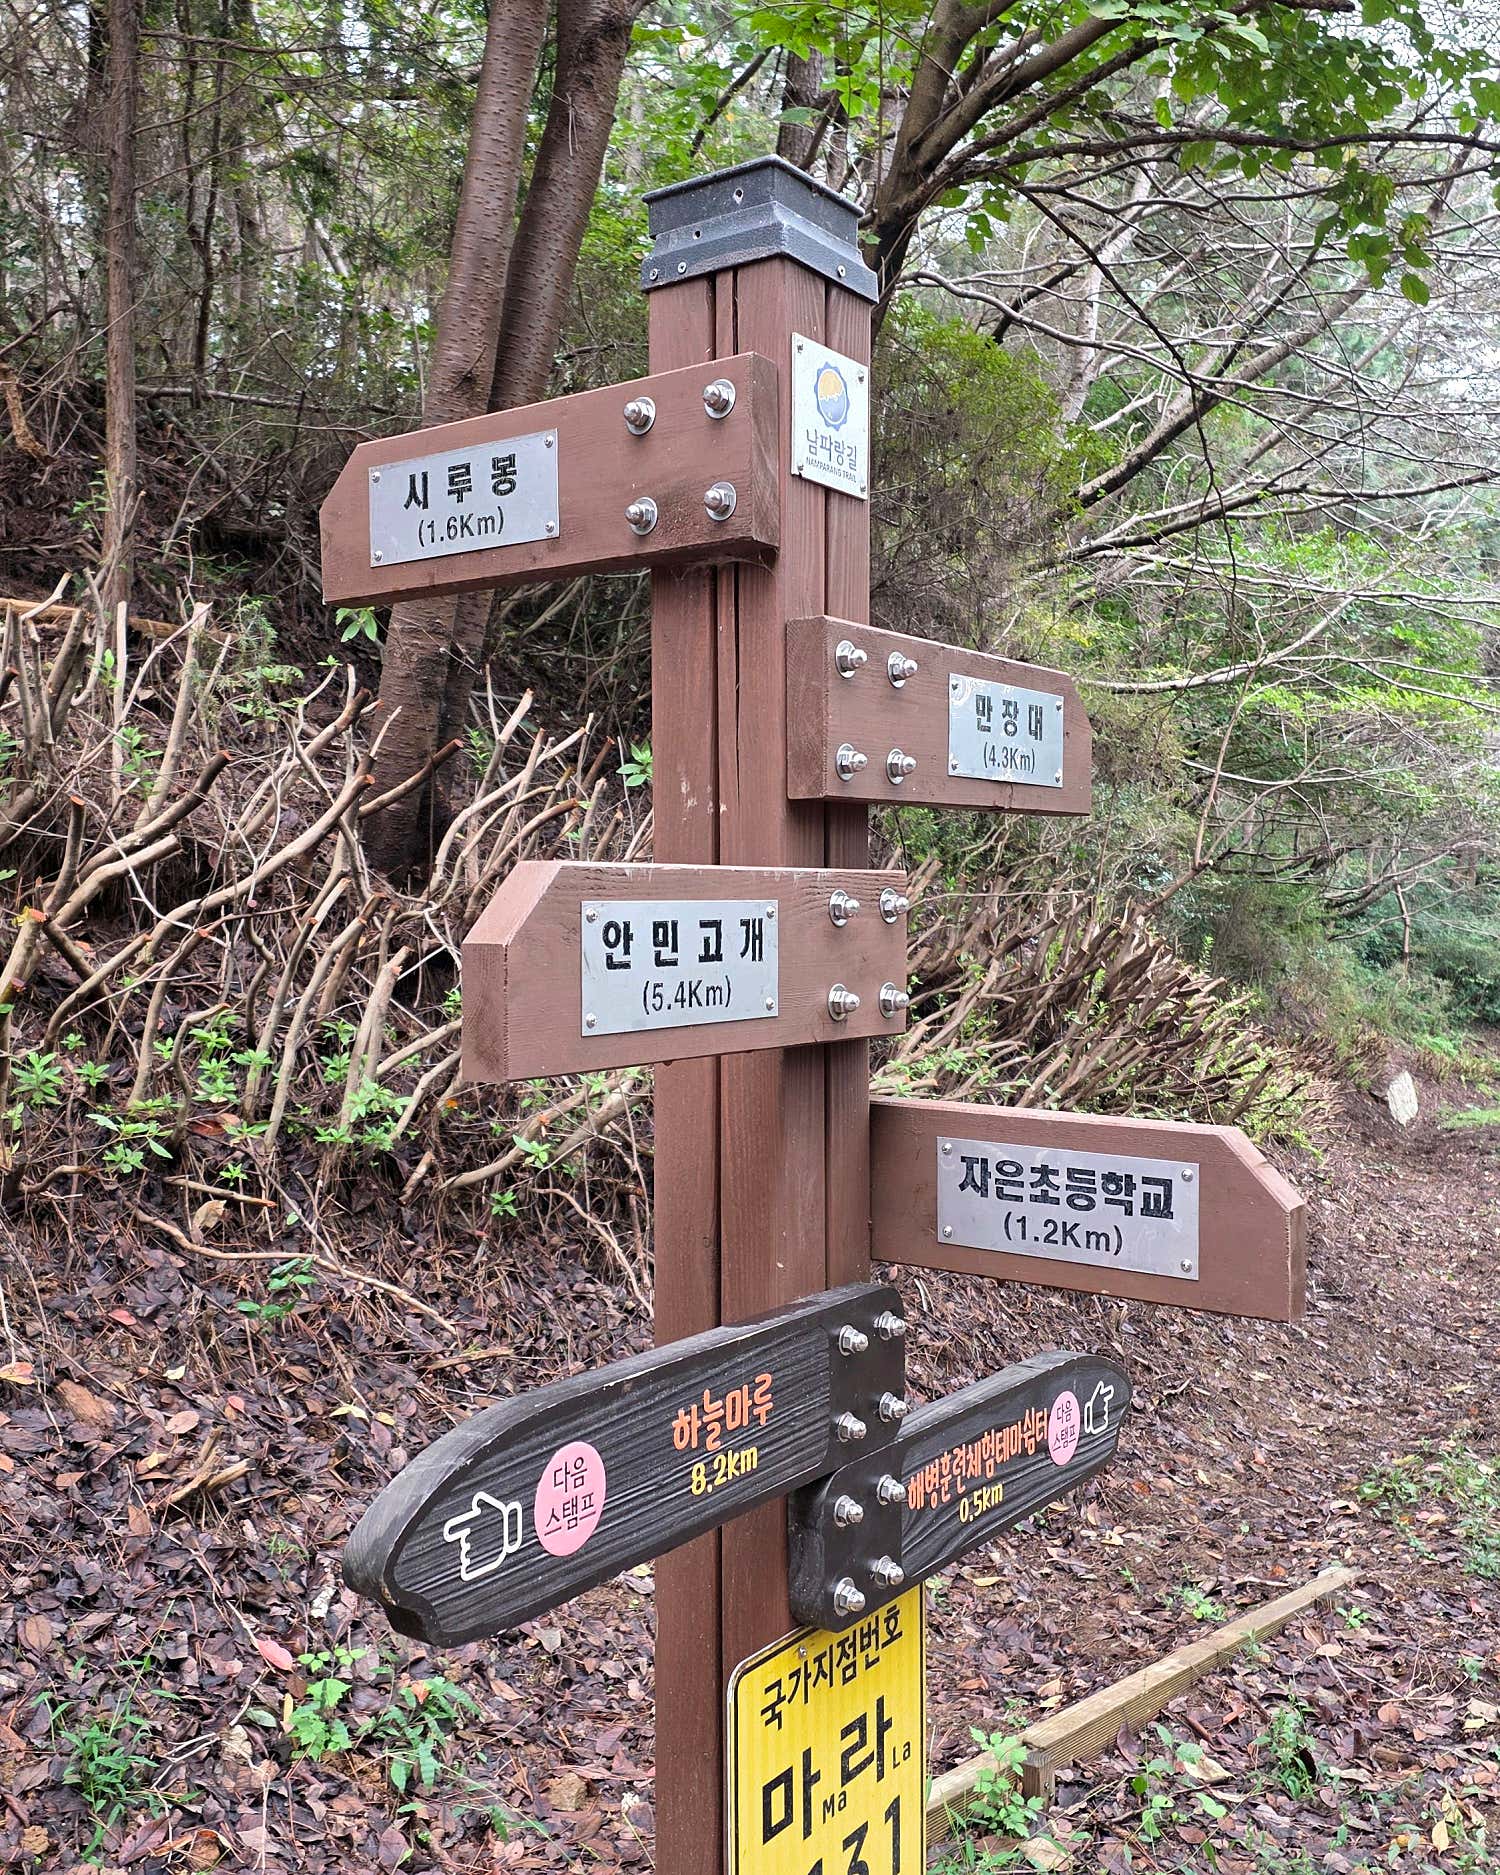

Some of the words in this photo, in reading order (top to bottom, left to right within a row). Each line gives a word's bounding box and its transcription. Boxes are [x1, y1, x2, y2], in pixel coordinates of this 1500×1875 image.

[806, 428, 857, 471] 남파랑길
[806, 456, 841, 477] NAMPARANG
[842, 469, 857, 483] TRAIL
[404, 453, 517, 510] 시루봉
[418, 506, 504, 547] (1.6Km)
[975, 694, 1043, 741] 만장대
[983, 742, 1035, 774] (4.3Km)
[602, 917, 763, 971] 안민고개
[643, 975, 732, 1015] (5.4Km)
[958, 1155, 1174, 1219] 자은초등학교
[1003, 1211, 1123, 1256] (1.2Km)
[672, 1373, 773, 1451] 하늘마루
[1056, 1400, 1073, 1424] 다음
[908, 1407, 1048, 1510] 해병훈련체험테마쉼터
[1052, 1424, 1077, 1452] 스탬프
[552, 1456, 588, 1493] 다음
[691, 1446, 758, 1496] 8.2km
[544, 1492, 597, 1537] 스탬프
[959, 1483, 1003, 1523] 0.5km
[760, 1604, 904, 1731] 국가지점번호
[892, 1740, 911, 1770] La
[822, 1790, 848, 1825] Ma
